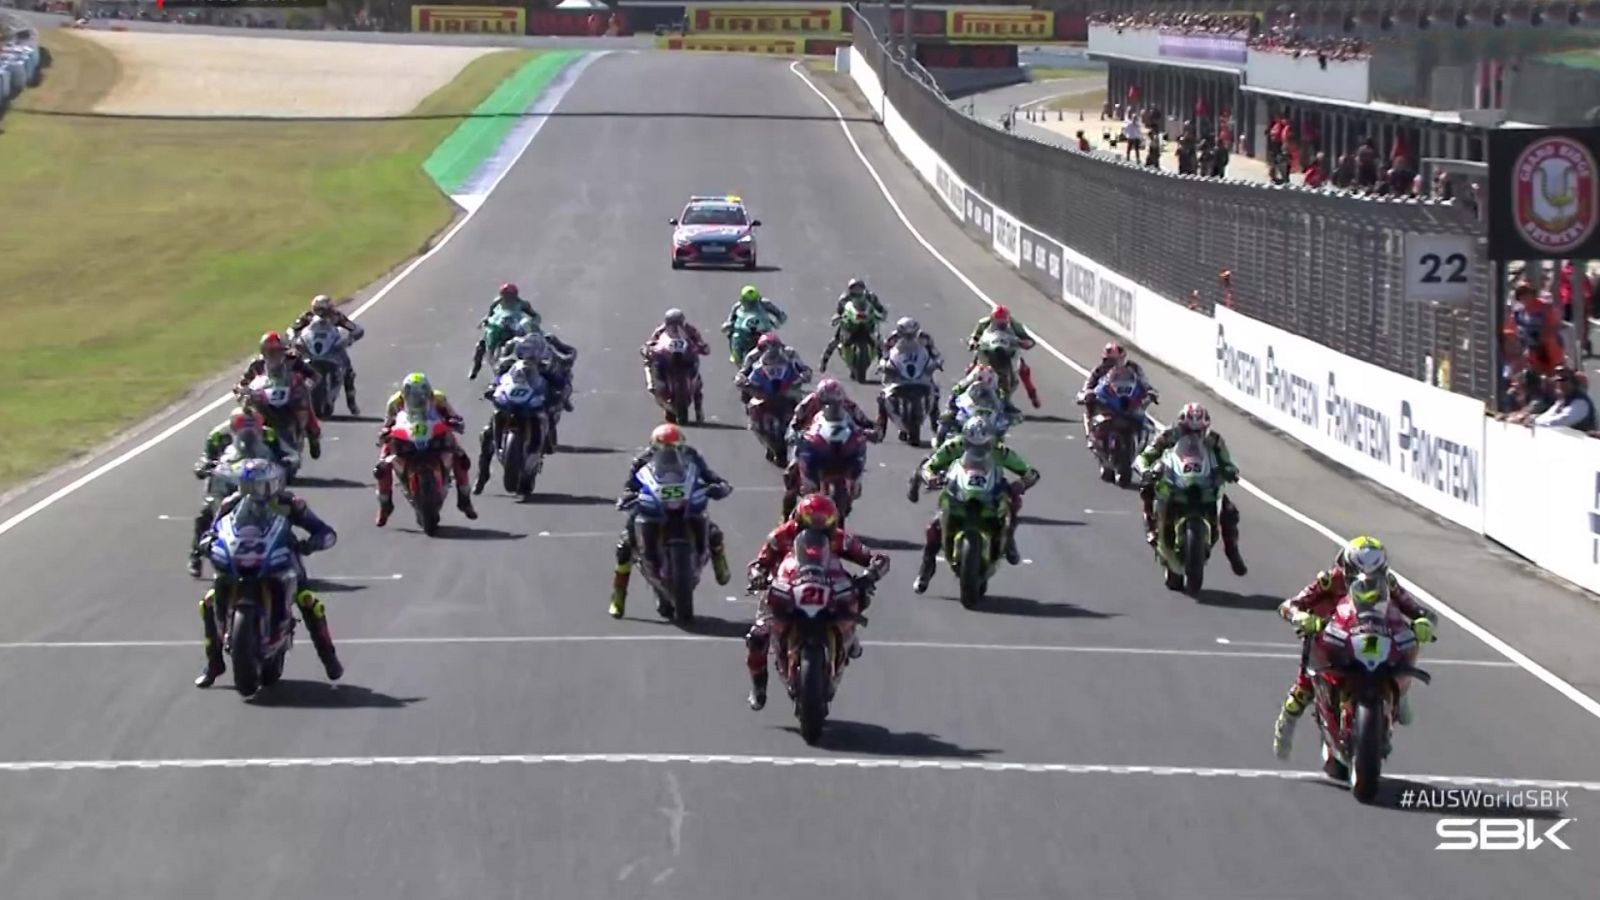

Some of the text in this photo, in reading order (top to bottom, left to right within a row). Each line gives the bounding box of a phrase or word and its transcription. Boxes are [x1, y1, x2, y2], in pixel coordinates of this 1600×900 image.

[419, 8, 518, 33] PIRELLI
[695, 8, 832, 32] PIRELLI
[953, 11, 1047, 35] PIRELLI
[1520, 145, 1555, 182] GRAND
[1419, 252, 1468, 283] 22
[1215, 323, 1261, 399] PROMETEON
[1265, 345, 1319, 429] PROMETEON
[1325, 370, 1391, 467] PROMETEON
[1398, 400, 1479, 508] PROMETEON
[660, 485, 685, 500] 55
[799, 586, 825, 606] 21
[1361, 635, 1379, 656] 1
